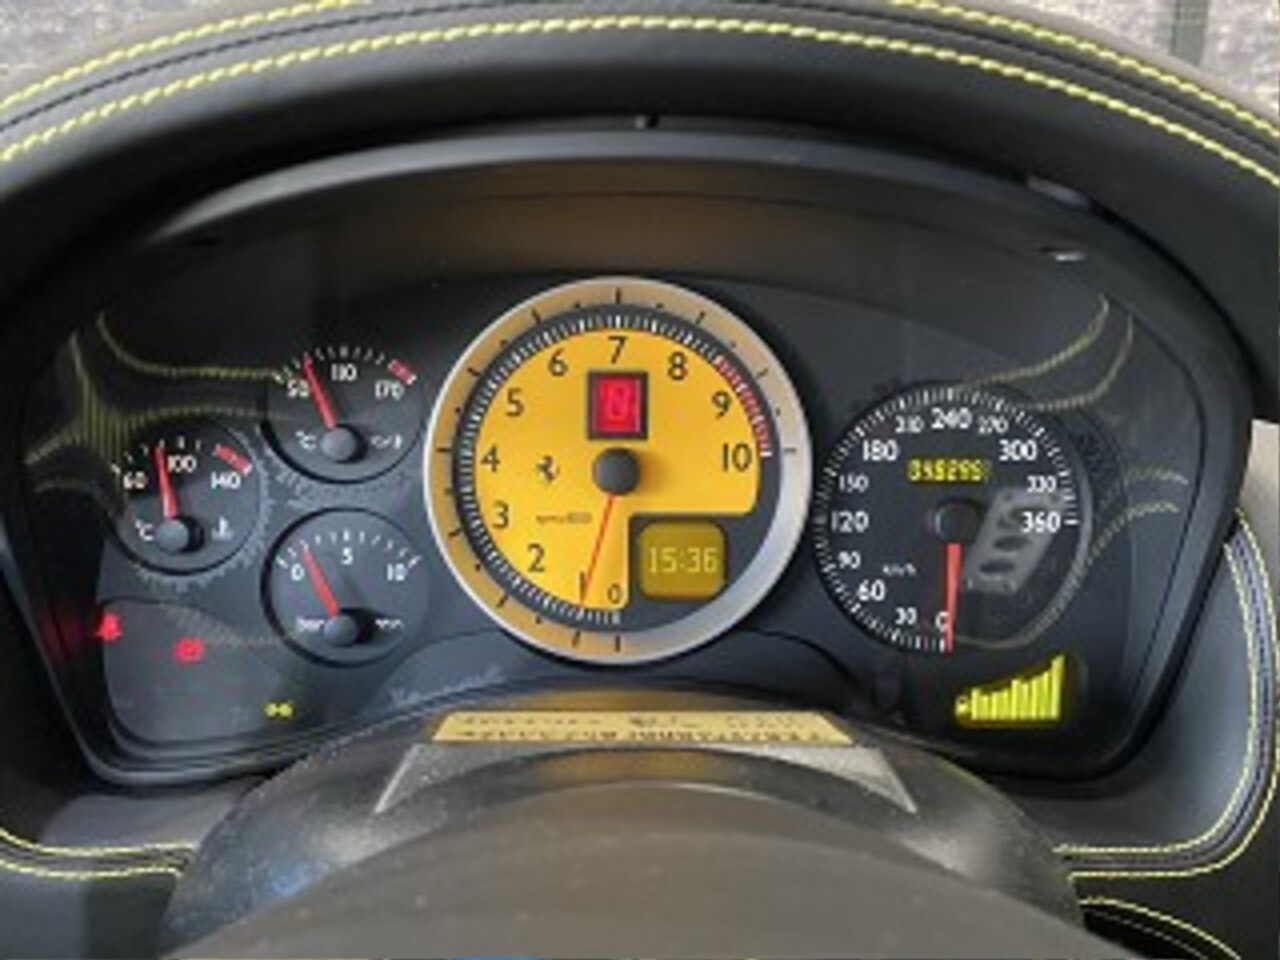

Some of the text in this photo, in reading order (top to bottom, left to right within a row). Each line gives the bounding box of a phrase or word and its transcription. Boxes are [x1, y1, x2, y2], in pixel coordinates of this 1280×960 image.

[609, 336, 628, 364] 7
[331, 362, 357, 381] 110
[548, 350, 568, 377] 6
[667, 352, 689, 381] 8
[374, 382, 403, 399] 170
[507, 388, 524, 417] 5
[712, 391, 731, 420] 9
[931, 408, 972, 430] 240
[481, 445, 498, 472] 4
[721, 443, 753, 472] 10
[862, 440, 899, 461] 180
[999, 440, 1037, 461] 300
[168, 455, 197, 473] 100
[211, 472, 241, 489] 140
[492, 501, 510, 528] 3
[831, 511, 869, 533] 120
[1022, 512, 1061, 533] 360
[342, 549, 353, 565] 5
[527, 544, 546, 572] 2
[649, 547, 718, 573] 15:36
[608, 583, 622, 604] 0
[857, 580, 885, 601] 60
